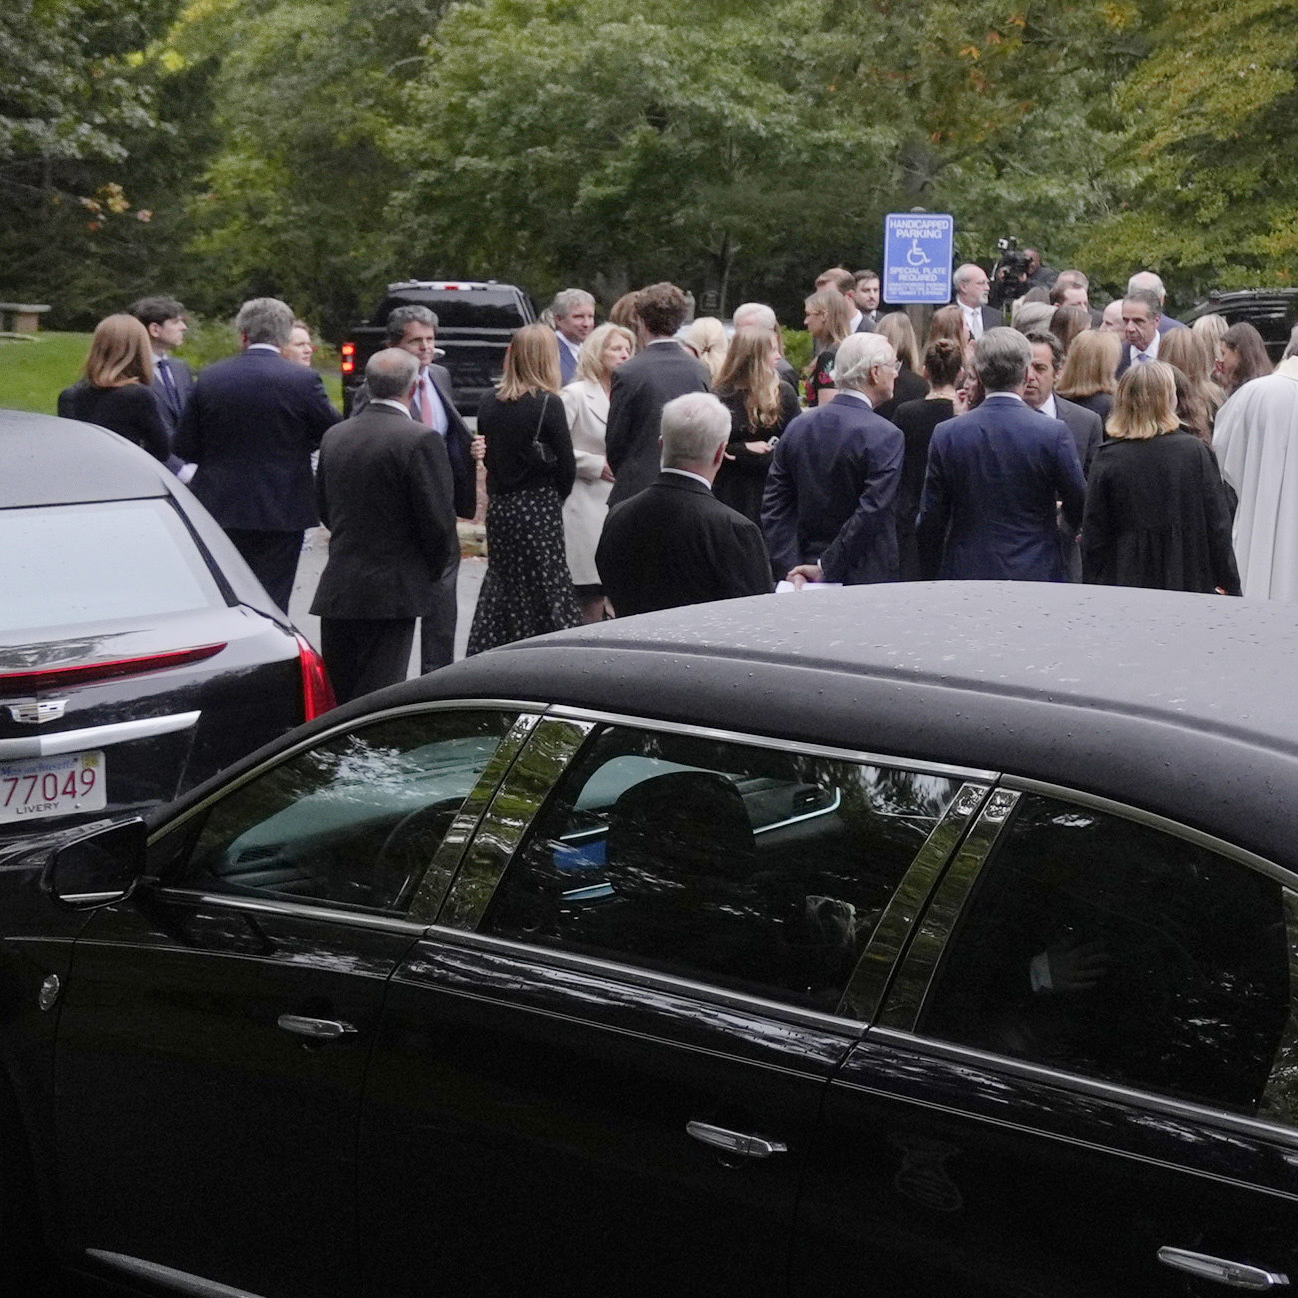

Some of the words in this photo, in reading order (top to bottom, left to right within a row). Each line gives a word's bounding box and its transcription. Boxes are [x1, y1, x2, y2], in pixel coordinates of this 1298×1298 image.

[890, 219, 949, 229] HANDICAPPED
[896, 229, 942, 239] PARKING
[890, 267, 919, 275] SPECIAL
[923, 267, 946, 275] PLATE
[898, 274, 938, 282] REQUIRED
[3, 768, 95, 807] 77049
[16, 801, 59, 815] LIVERY
